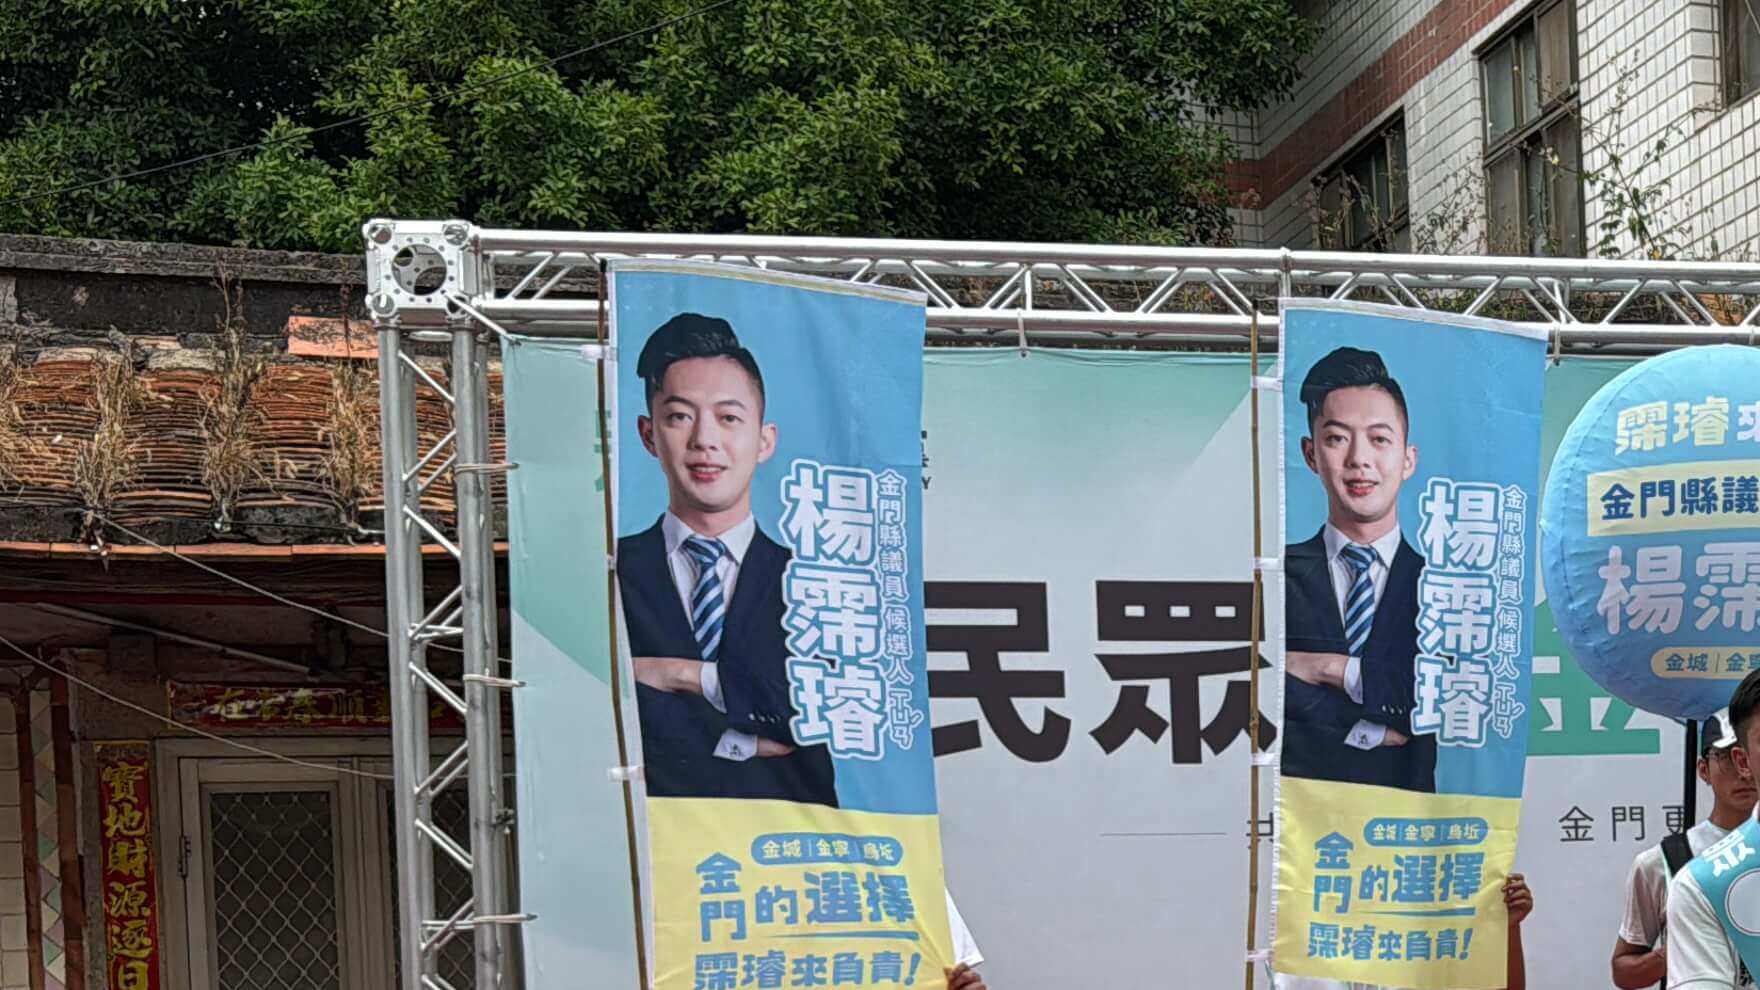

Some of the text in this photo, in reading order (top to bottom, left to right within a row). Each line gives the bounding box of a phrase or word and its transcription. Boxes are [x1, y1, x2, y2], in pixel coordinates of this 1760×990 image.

[783, 461, 886, 758] 楊霈璿
[877, 469, 913, 683] 金門縣議員候選人
[1415, 482, 1498, 744] 楊霈璿
[1496, 486, 1526, 677] 金門縣議員候選人
[1665, 652, 1707, 672] 金城
[696, 852, 916, 942] 金門 的選擇
[1314, 832, 1485, 914] 金門 的選擇
